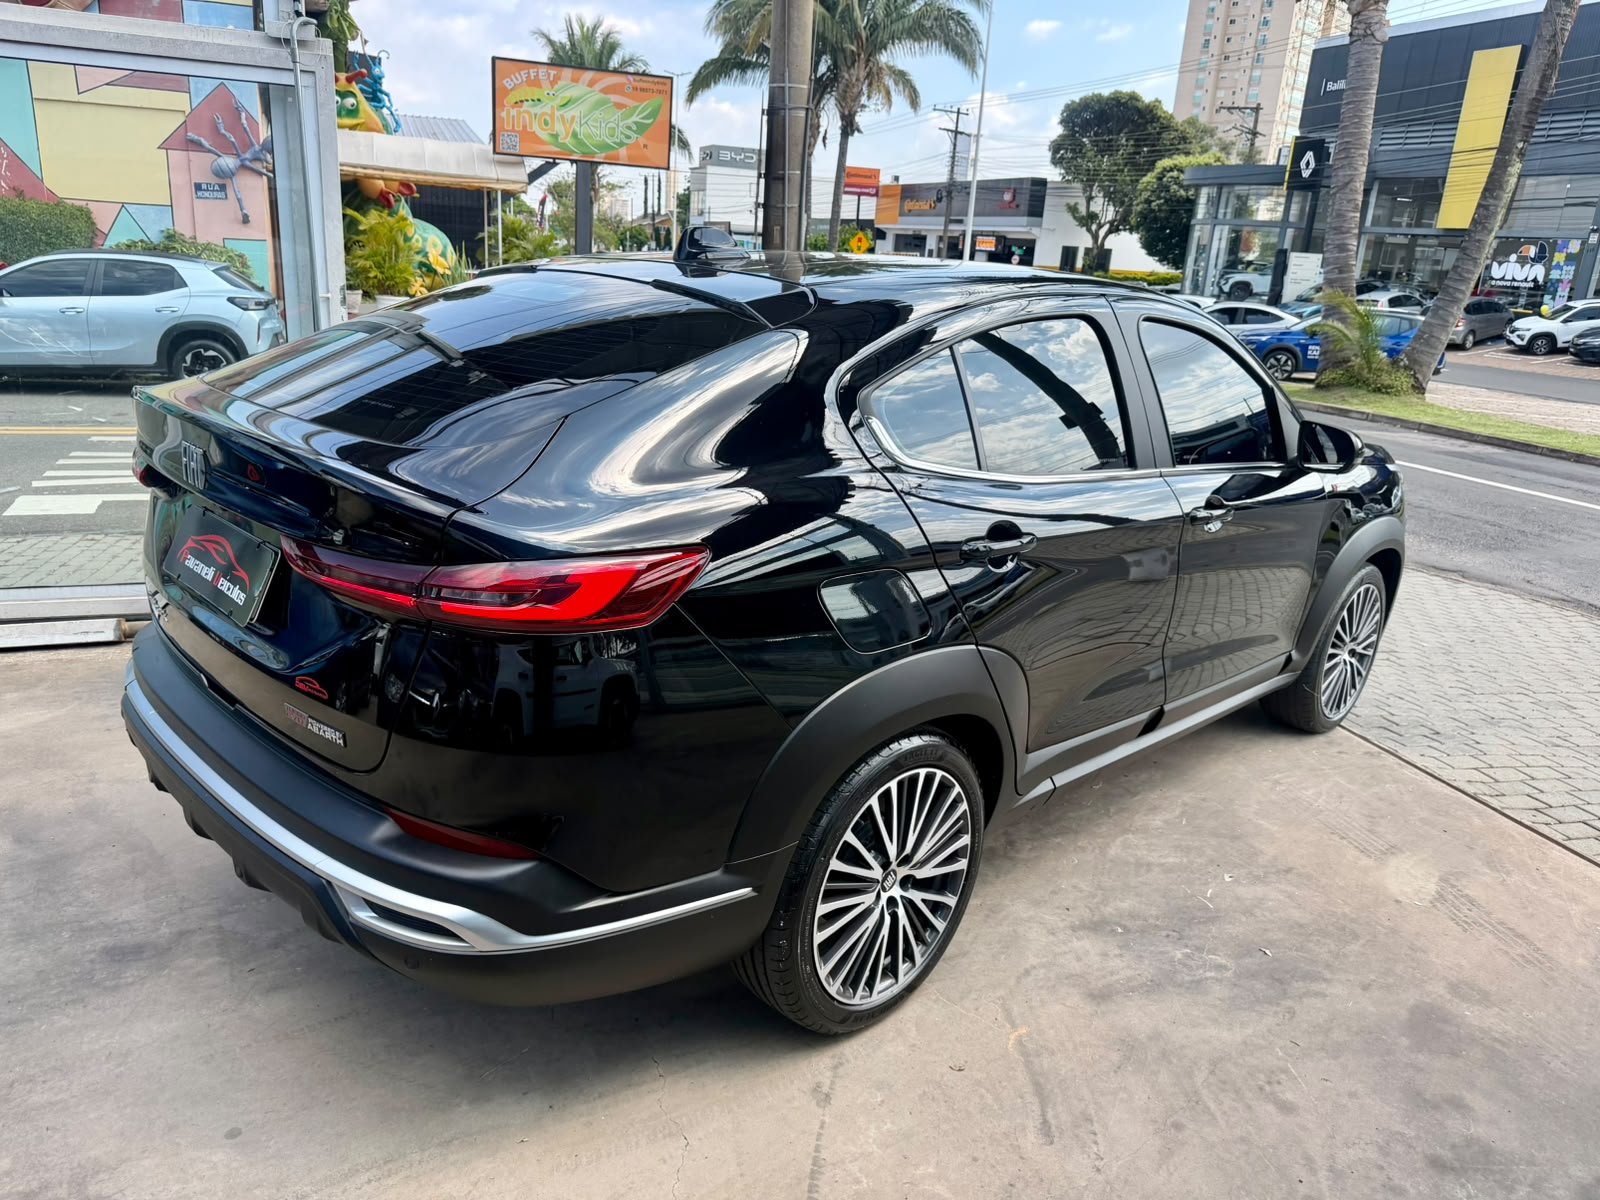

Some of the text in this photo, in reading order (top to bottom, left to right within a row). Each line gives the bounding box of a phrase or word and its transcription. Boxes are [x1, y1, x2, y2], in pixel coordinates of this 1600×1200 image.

[503, 69, 557, 89] BUFFET
[719, 150, 756, 163] BYD
[181, 440, 205, 490] FIAT
[307, 722, 344, 747] ABARTH
